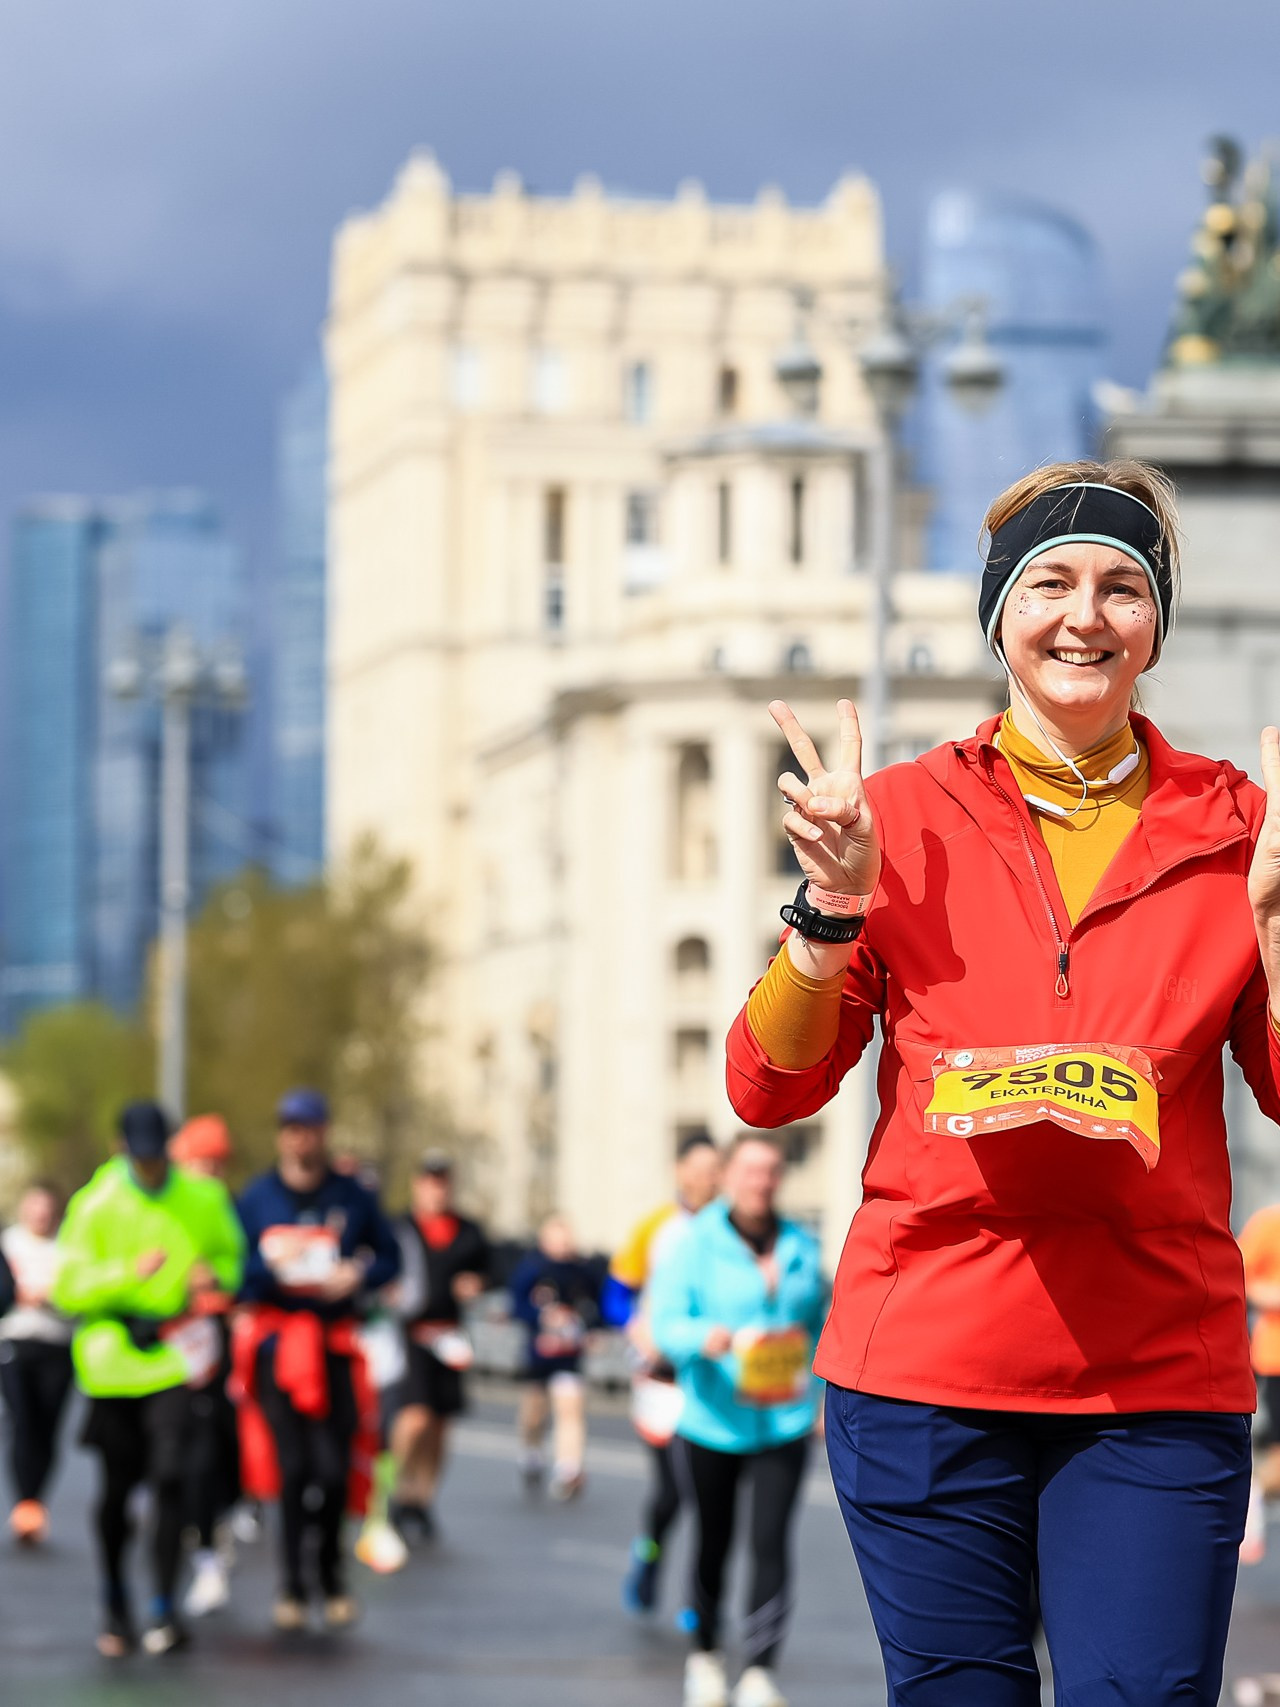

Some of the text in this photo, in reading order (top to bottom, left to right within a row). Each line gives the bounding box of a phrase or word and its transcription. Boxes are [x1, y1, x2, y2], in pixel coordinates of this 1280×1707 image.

[961, 1060, 1139, 1102] 9505
[990, 1086, 1108, 1111] ЕКАТЕРИНА
[946, 1114, 975, 1136] G
